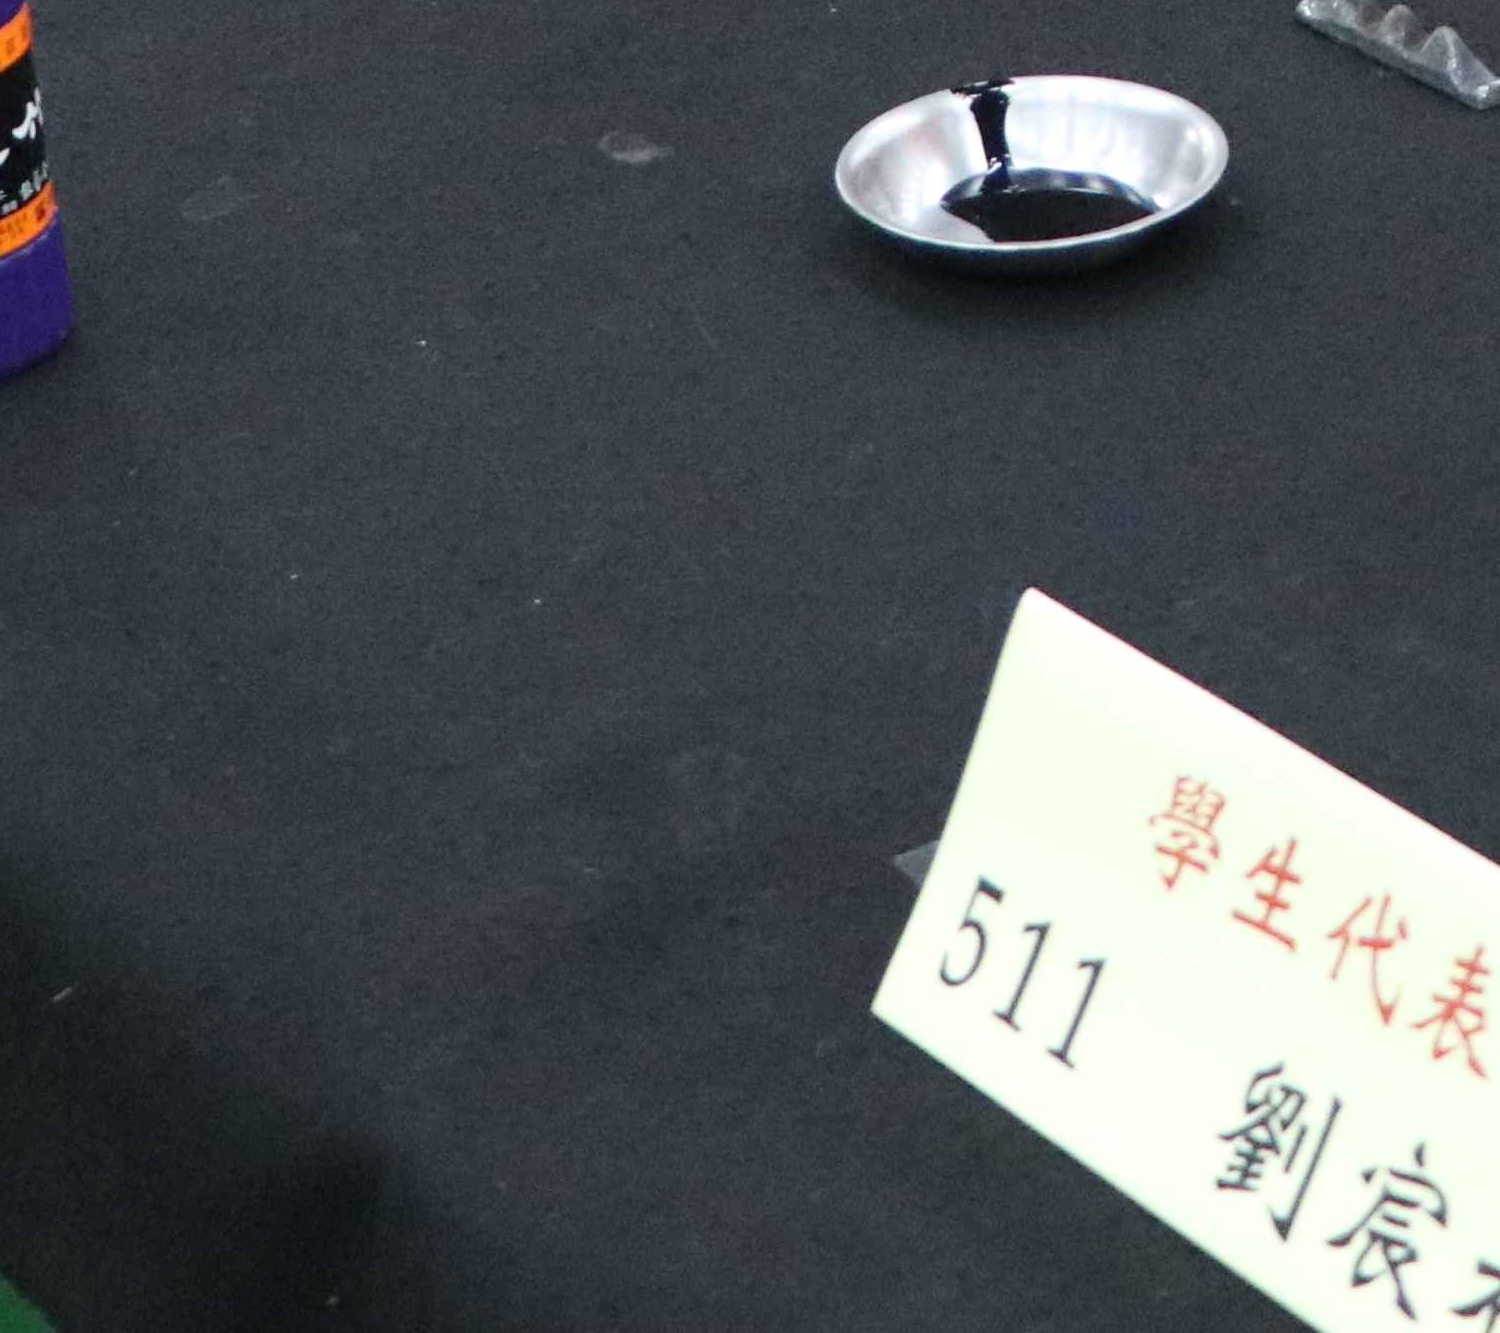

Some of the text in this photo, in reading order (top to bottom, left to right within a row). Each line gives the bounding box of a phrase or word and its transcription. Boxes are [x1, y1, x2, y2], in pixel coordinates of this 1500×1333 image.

[938, 875, 1107, 1071] 511
[1147, 774, 1490, 1080] 學生代表
